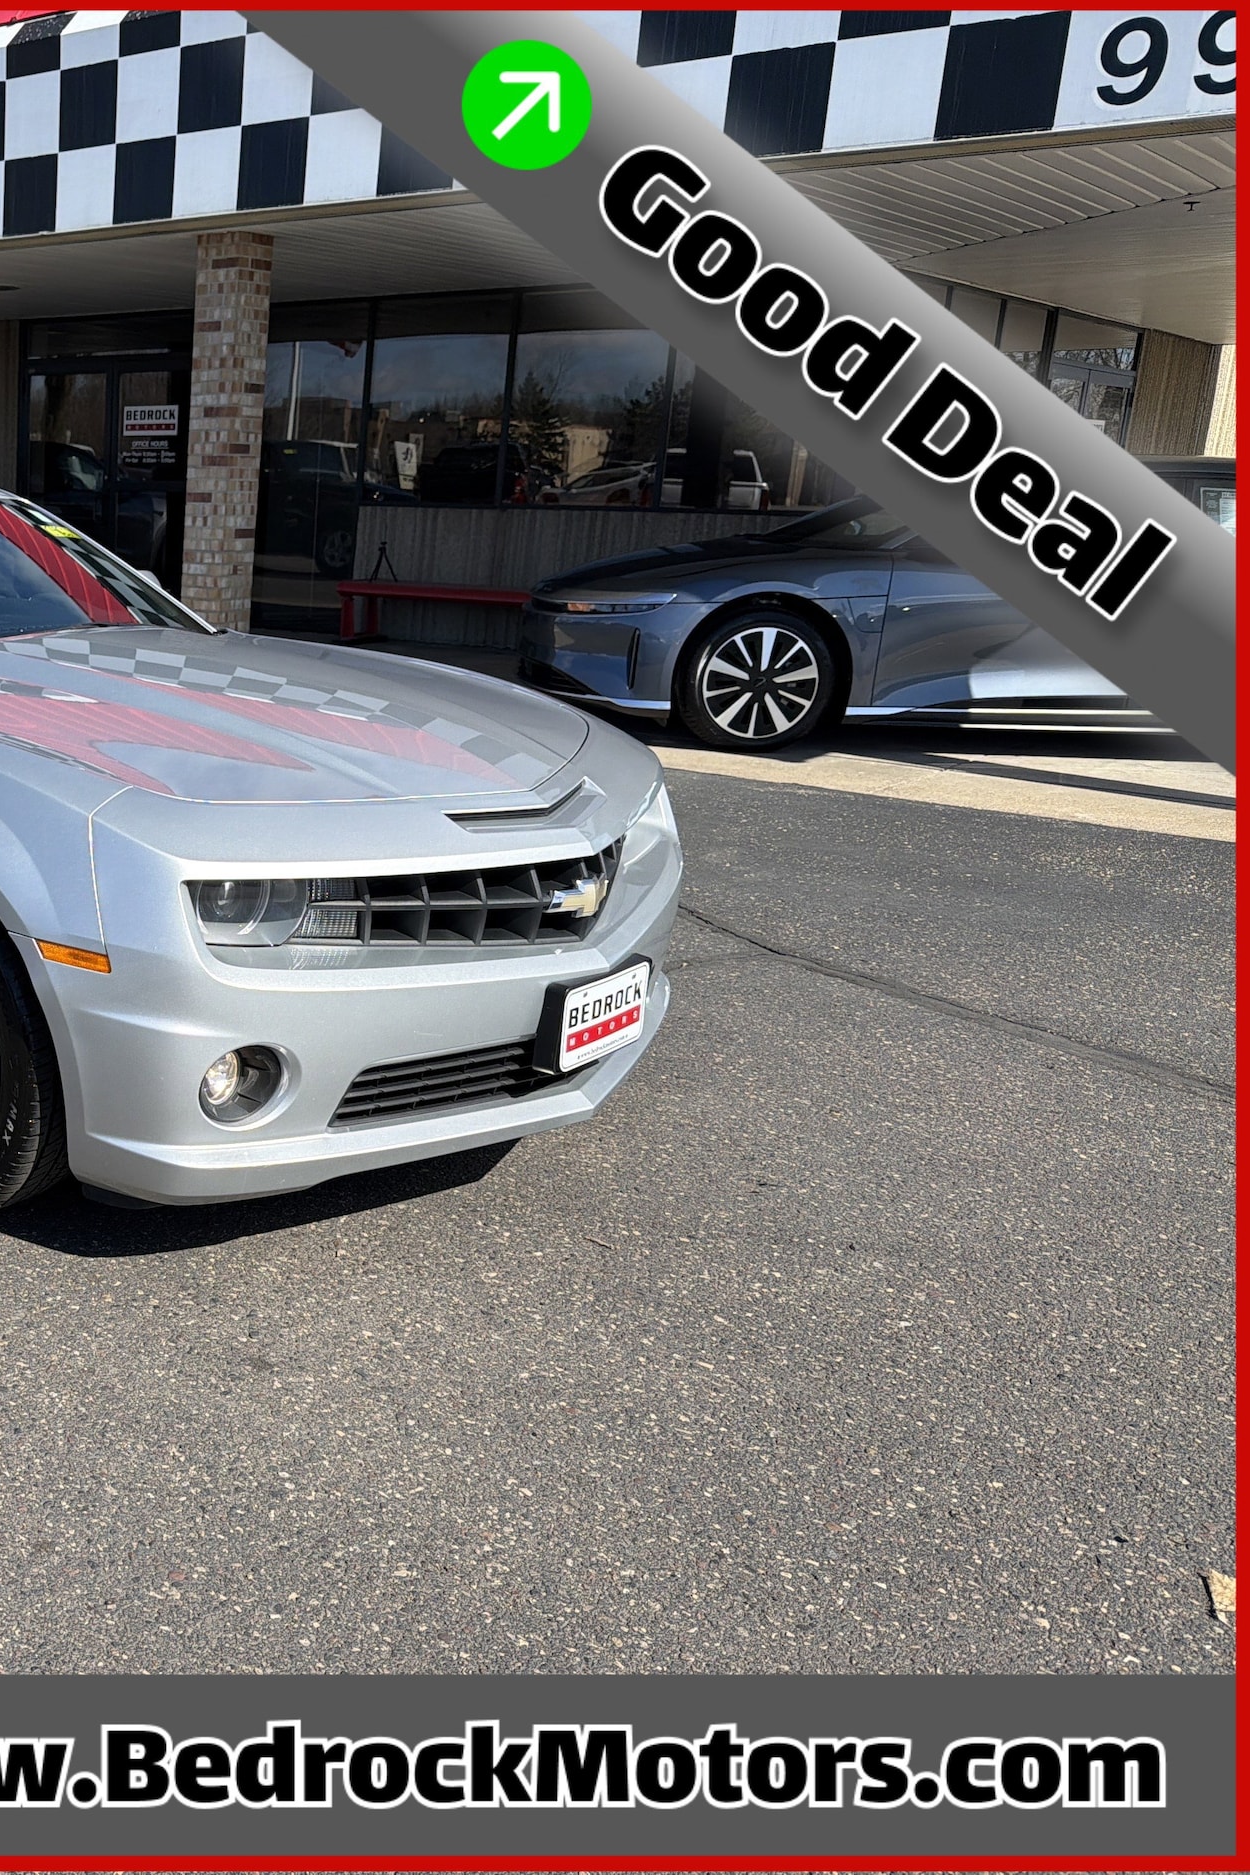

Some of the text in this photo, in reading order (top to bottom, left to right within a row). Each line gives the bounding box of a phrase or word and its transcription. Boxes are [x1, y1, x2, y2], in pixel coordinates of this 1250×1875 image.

[126, 409, 175, 420] BEDROCK
[568, 980, 642, 1029] BEDROCK
[569, 1010, 638, 1047] MOTORS
